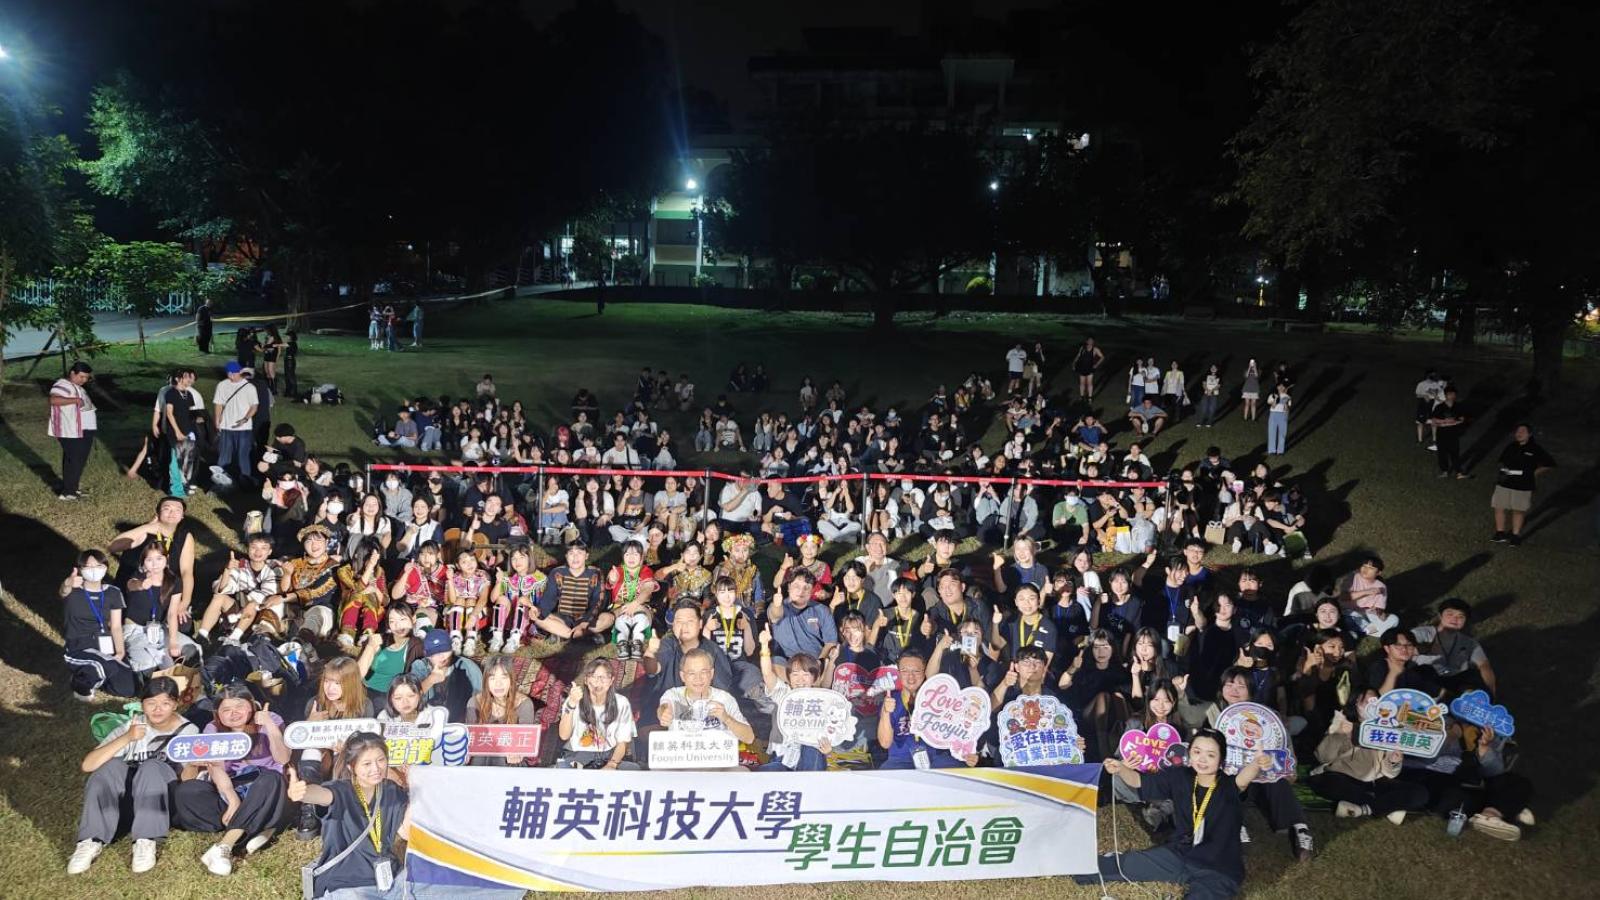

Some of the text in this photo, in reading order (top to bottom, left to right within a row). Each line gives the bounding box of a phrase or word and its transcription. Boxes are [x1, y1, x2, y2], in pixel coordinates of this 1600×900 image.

[921, 684, 962, 713] Love
[784, 699, 824, 716] 輔英
[944, 710, 953, 720] in
[783, 719, 825, 727] FOOYIN
[917, 712, 970, 739] Fooyin
[652, 739, 734, 751] 輔英科技大學
[1011, 729, 1068, 750] 愛在輔英
[1135, 736, 1167, 749] LOVE
[1369, 729, 1433, 750] 我在輔英
[652, 752, 734, 764] Fooyin University
[1151, 748, 1161, 756] IN
[499, 786, 802, 840] 輔英科技大學
[785, 816, 1024, 871] 學生自治會
